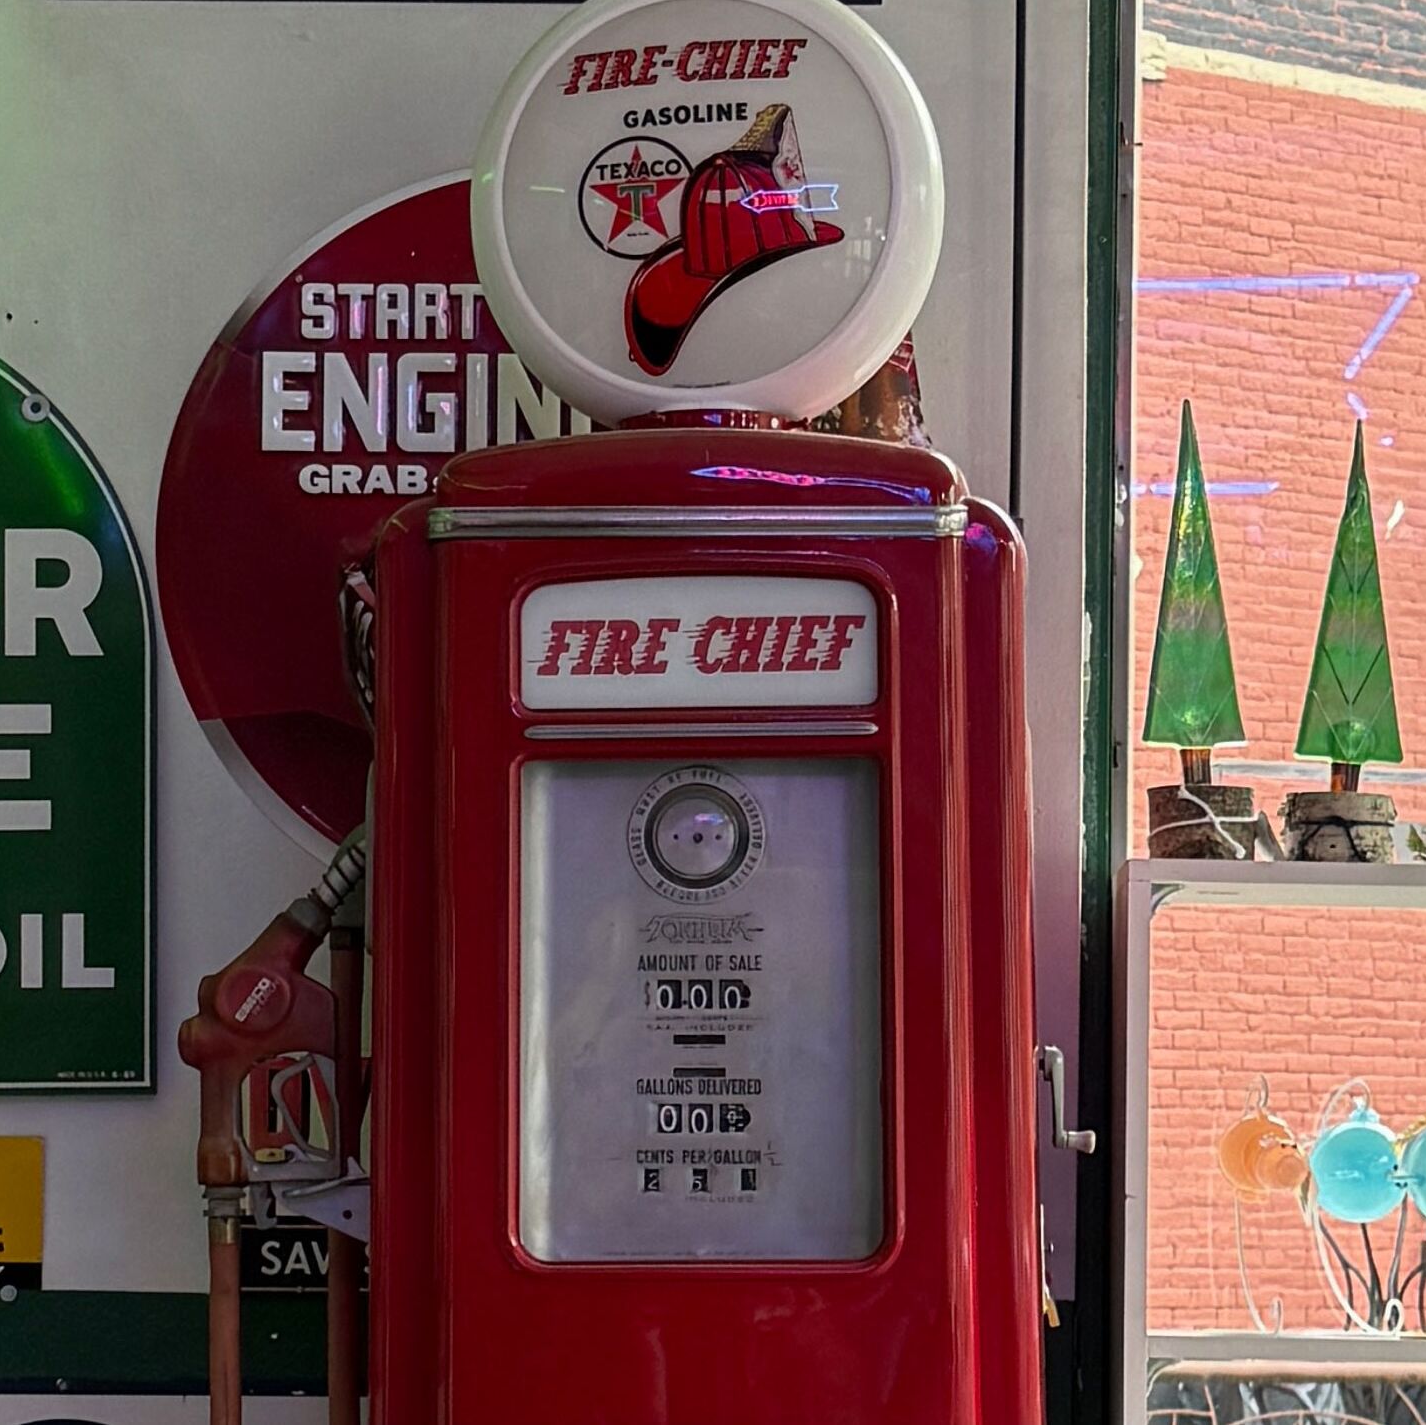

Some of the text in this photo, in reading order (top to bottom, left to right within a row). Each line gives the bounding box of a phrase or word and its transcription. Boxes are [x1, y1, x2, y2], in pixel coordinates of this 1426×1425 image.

[561, 38, 809, 96] FIRE-CHIEF
[623, 102, 749, 129] GASOLINE
[595, 158, 683, 182] TEXACO
[300, 282, 487, 341] START
[535, 615, 867, 677] FIRE CHIEF
[636, 954, 763, 974] AMOUNT OF SALE
[636, 1077, 763, 1096] GALLONS DELIVERED
[636, 1148, 762, 1165] CENTS PER GALLON
